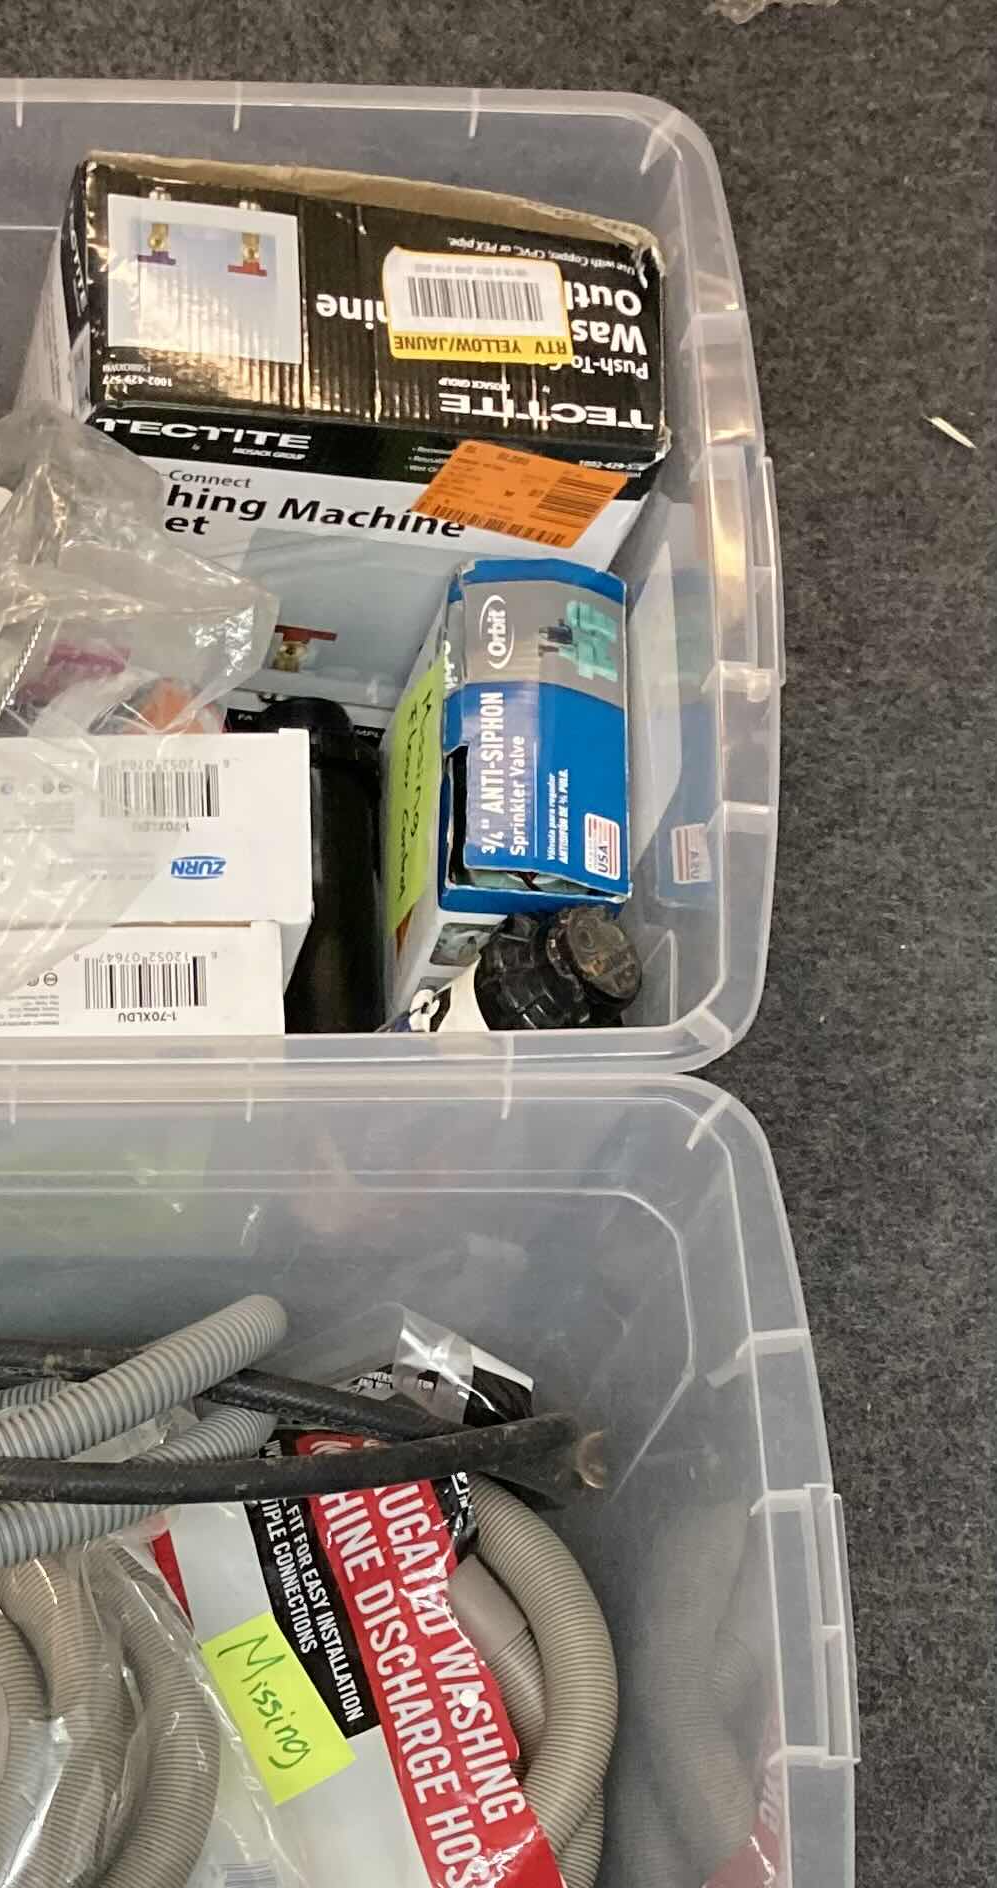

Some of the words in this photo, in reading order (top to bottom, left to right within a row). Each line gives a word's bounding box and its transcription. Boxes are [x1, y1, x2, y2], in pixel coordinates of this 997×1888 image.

[475, 241, 495, 253] PEX
[566, 281, 643, 317] Outl
[394, 334, 523, 354] YELLOW/JAUNE
[534, 337, 568, 355] RTV
[438, 378, 469, 388] GROUP
[440, 394, 654, 430] TECTITE
[95, 418, 313, 450] TECTITE
[277, 497, 466, 538] Machine
[487, 609, 506, 659] Orbit
[480, 691, 504, 814] ANTI-SIPHON
[510, 735, 527, 776] Valve
[509, 777, 530, 856] Sprinkler
[171, 859, 227, 875] ZURN
[596, 845, 609, 874] USA
[117, 1011, 177, 1023] 1-70XLDU
[286, 1504, 303, 1531] FIT
[294, 1530, 314, 1559] FOR
[271, 1540, 318, 1654] CONNECTIONS
[303, 1558, 330, 1610] EASY
[316, 1609, 365, 1723] INSTALLATION
[217, 1634, 313, 1770] Missing
[354, 1579, 461, 1805] DISCHARGE
[430, 1643, 527, 1825] WASHING
